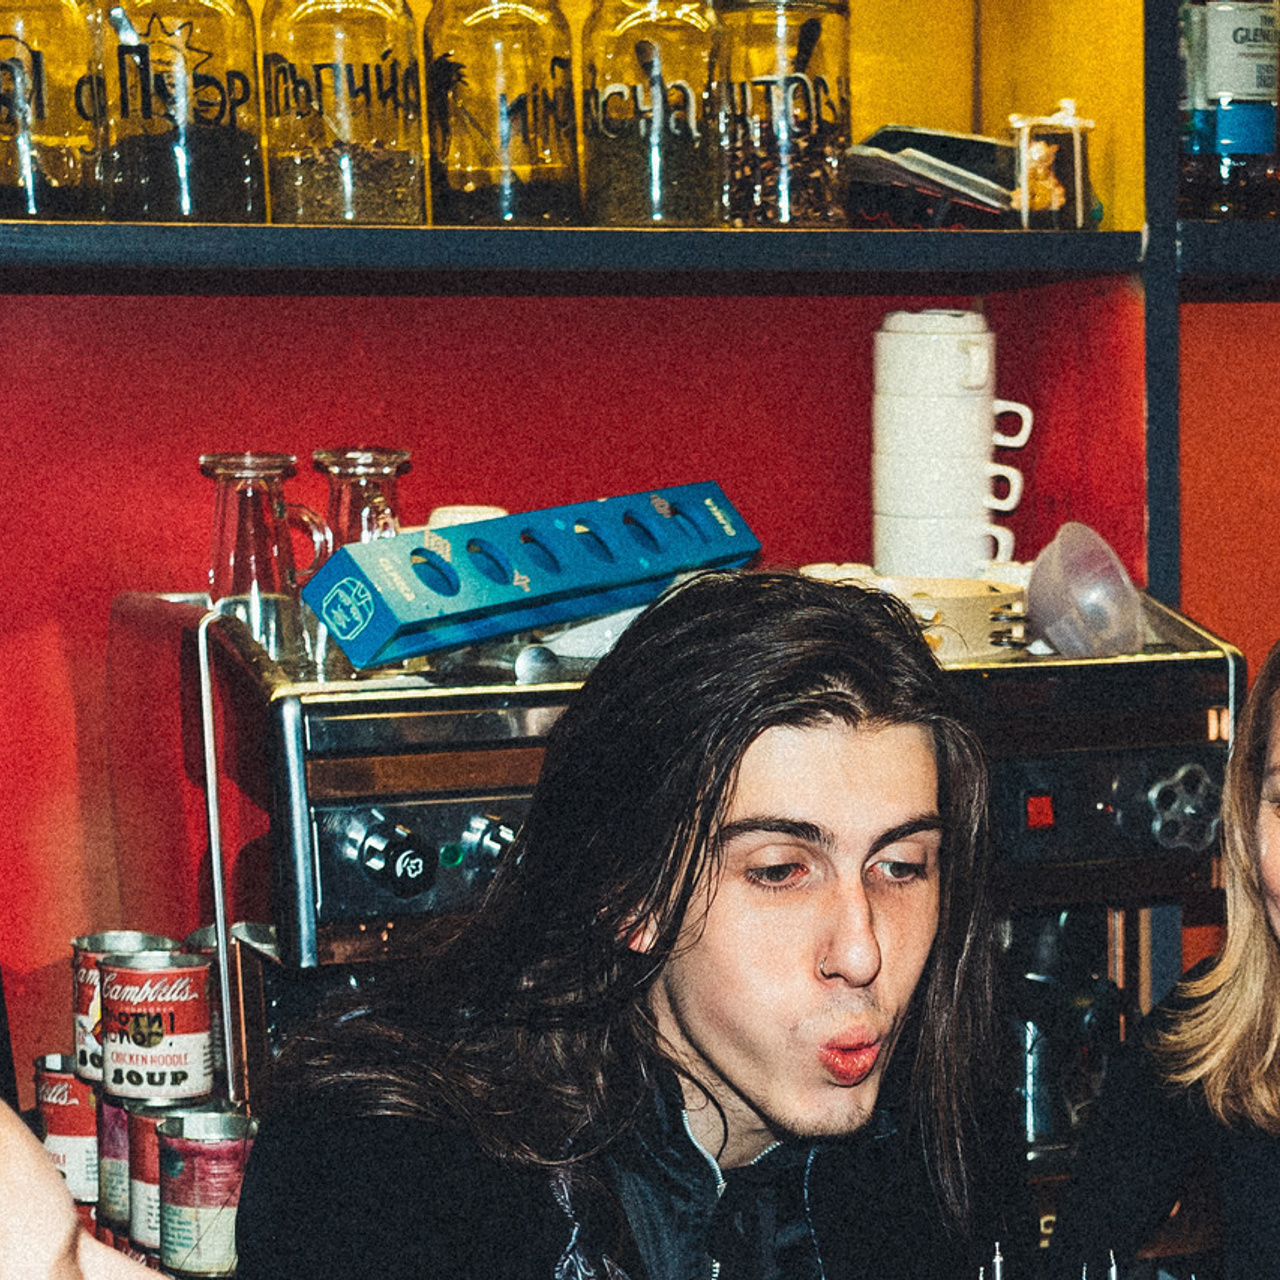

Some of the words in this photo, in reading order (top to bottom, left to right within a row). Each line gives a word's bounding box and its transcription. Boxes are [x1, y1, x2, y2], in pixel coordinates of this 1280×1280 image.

[103, 973, 199, 1005] Campbell's
[111, 1051, 147, 1066] CHICKEN
[150, 1053, 188, 1067] NOODLE
[111, 1068, 189, 1087] SOUP
